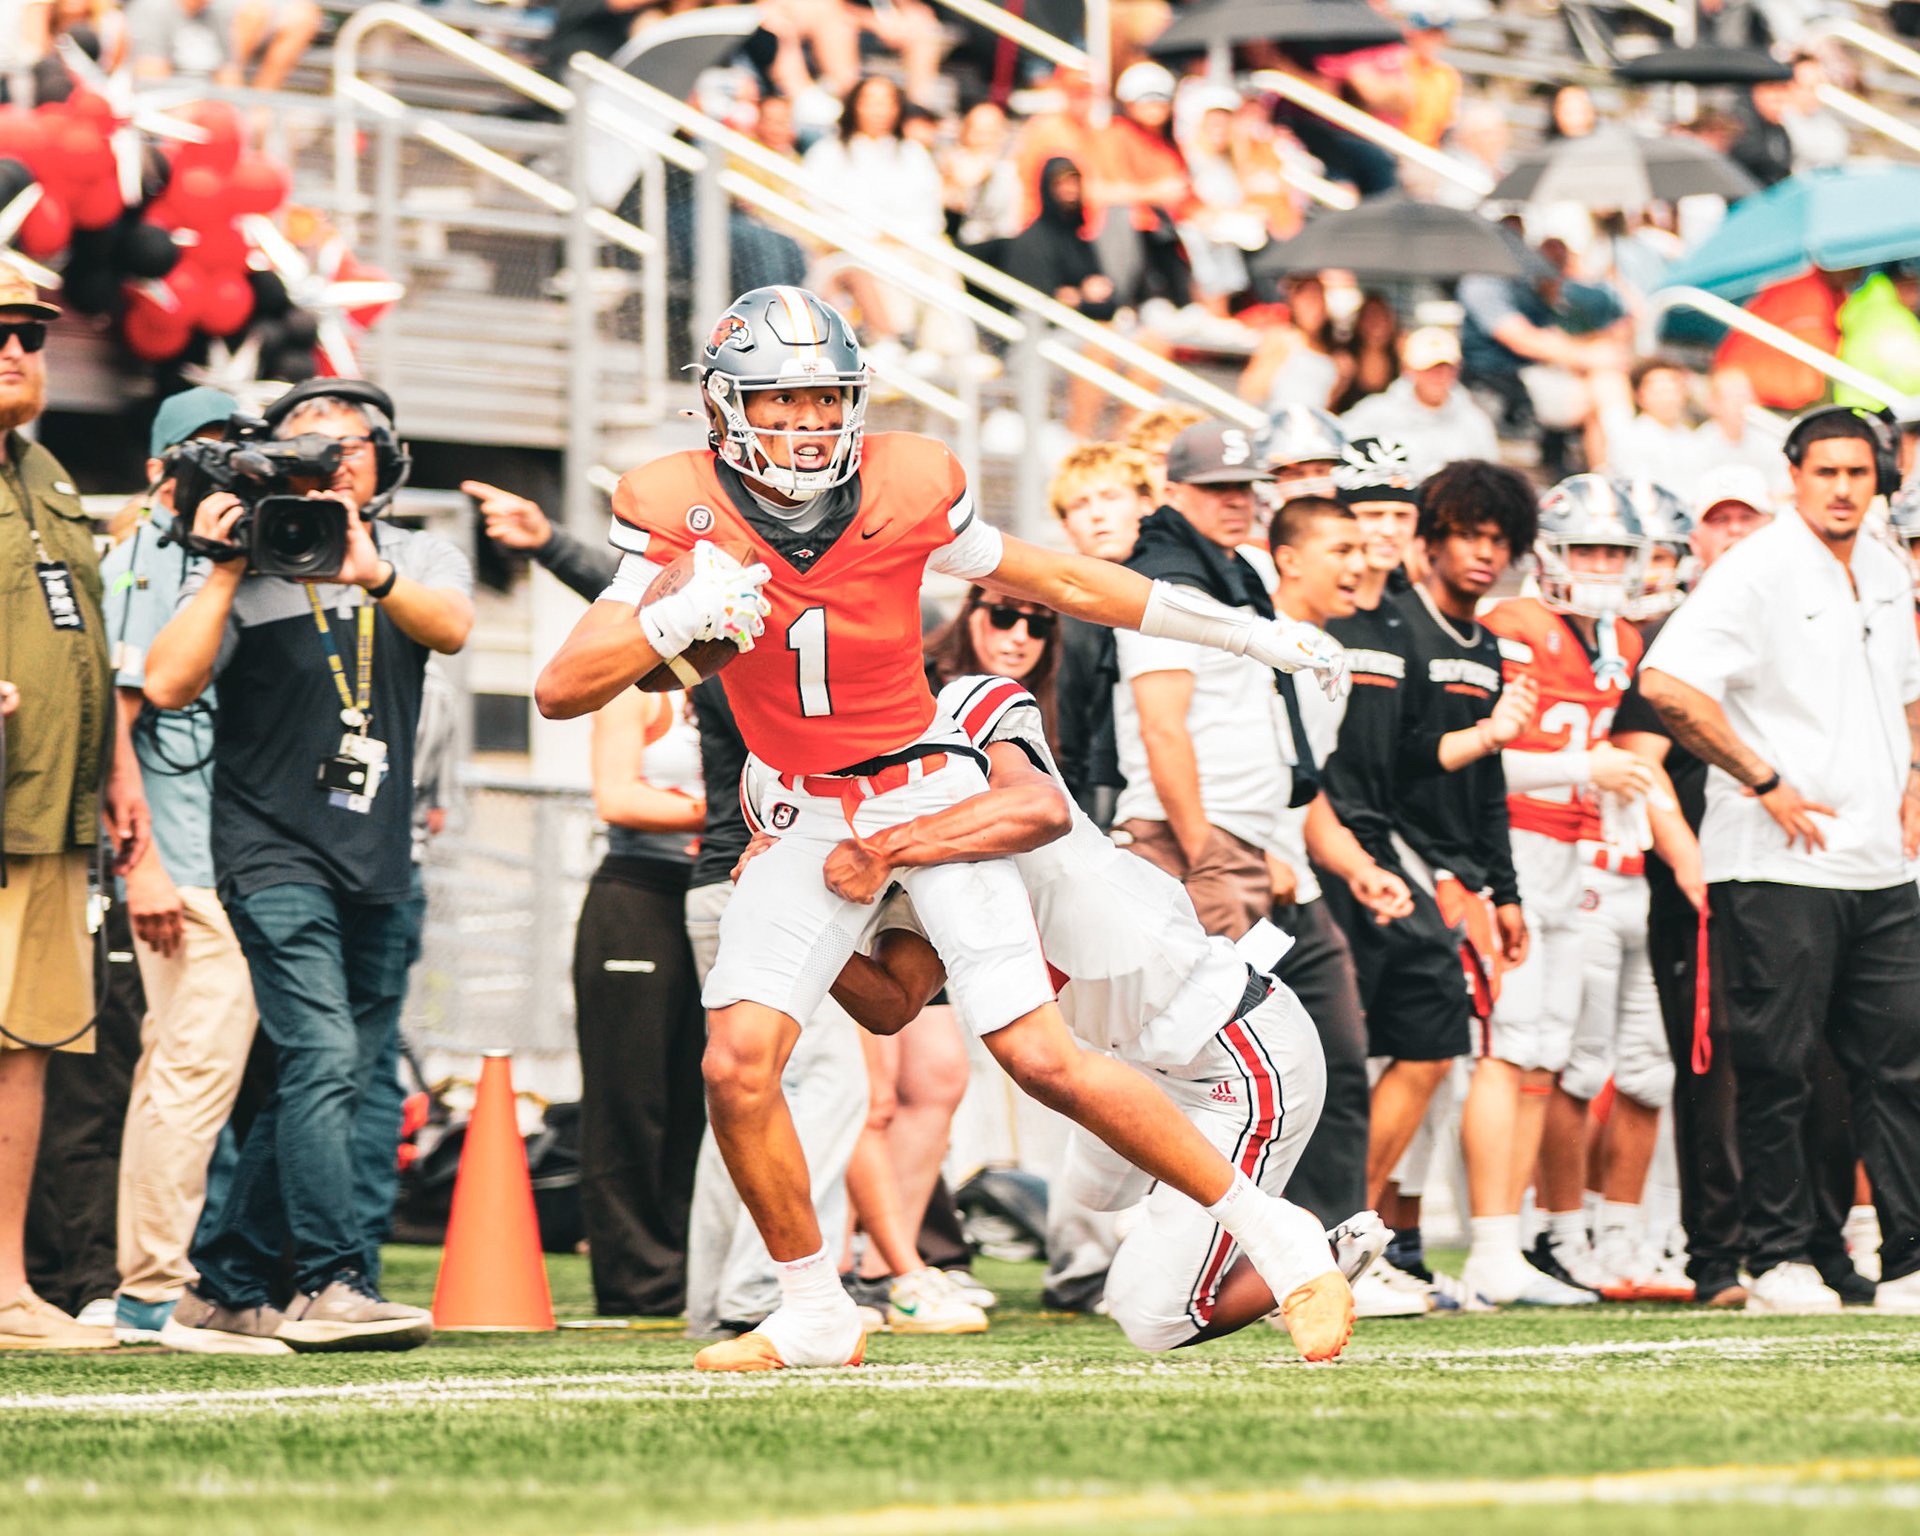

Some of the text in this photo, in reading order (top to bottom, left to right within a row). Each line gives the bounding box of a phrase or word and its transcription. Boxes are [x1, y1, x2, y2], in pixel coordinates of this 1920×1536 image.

[1221, 428, 1250, 466] S
[691, 509, 710, 529] S
[785, 606, 833, 717] 1
[773, 803, 796, 828] S
